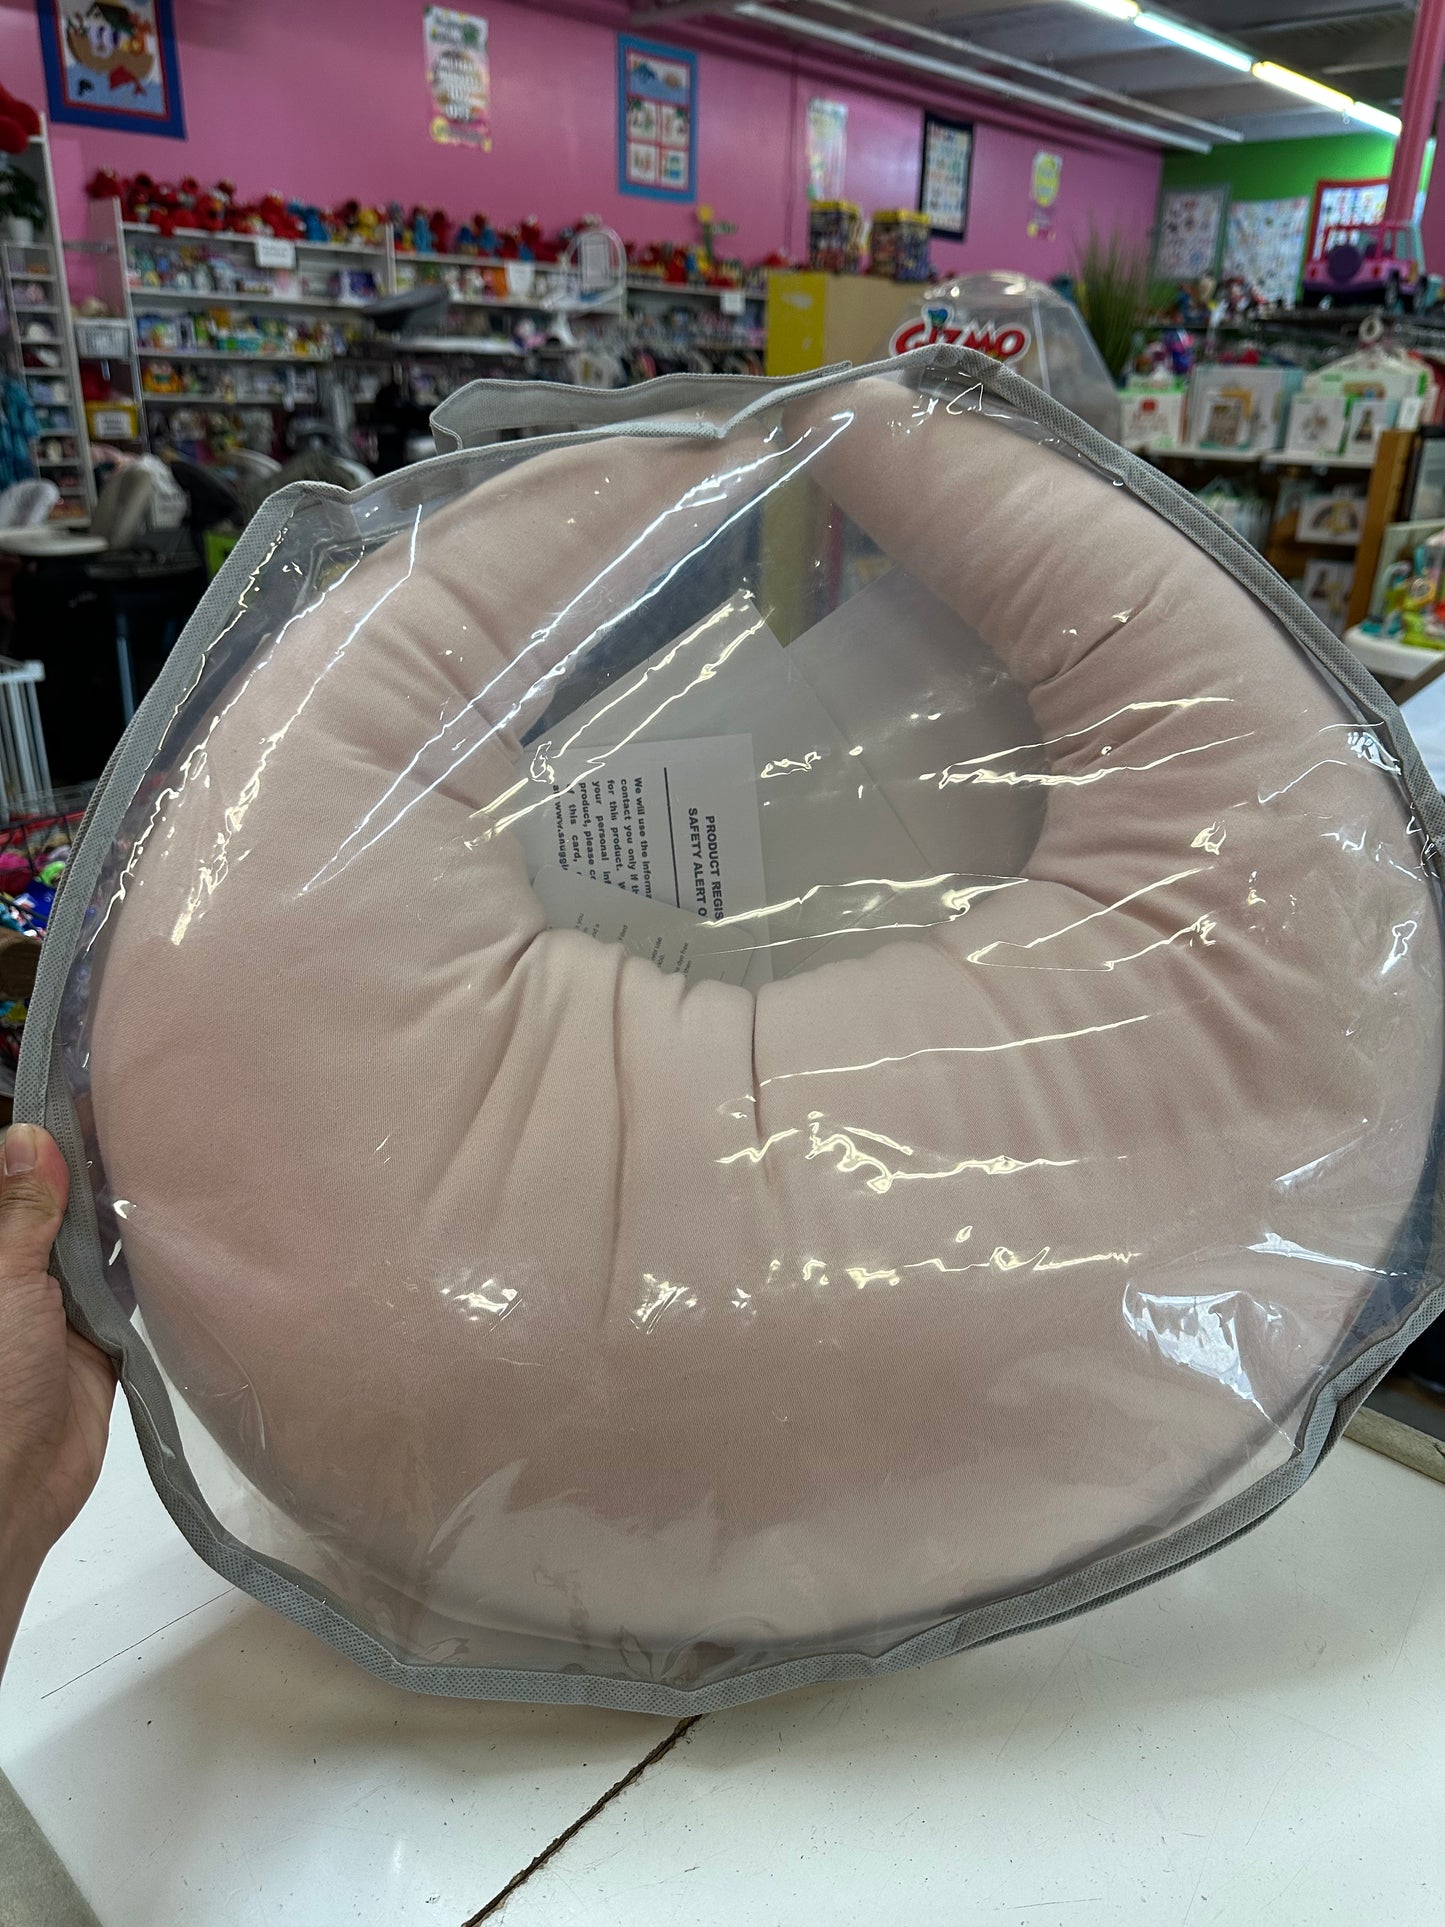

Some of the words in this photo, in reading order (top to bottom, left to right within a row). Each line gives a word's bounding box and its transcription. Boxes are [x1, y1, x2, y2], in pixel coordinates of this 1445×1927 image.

[893, 314, 1027, 358] GIZMO
[592, 781, 602, 804] your
[607, 780, 615, 795] for
[634, 777, 642, 794] We
[579, 782, 591, 827] product,
[610, 801, 618, 820] this
[621, 779, 631, 820] contact
[636, 797, 645, 815] will
[569, 804, 578, 825] this
[596, 815, 609, 861] personal
[624, 825, 632, 843] you
[689, 808, 702, 859] SAFETY
[706, 816, 720, 876] PRODUCT
[572, 835, 582, 862] card,
[584, 831, 594, 865] please
[611, 827, 623, 871] product.
[627, 849, 637, 870] only
[640, 841, 648, 858] the
[693, 862, 706, 904] ALERT
